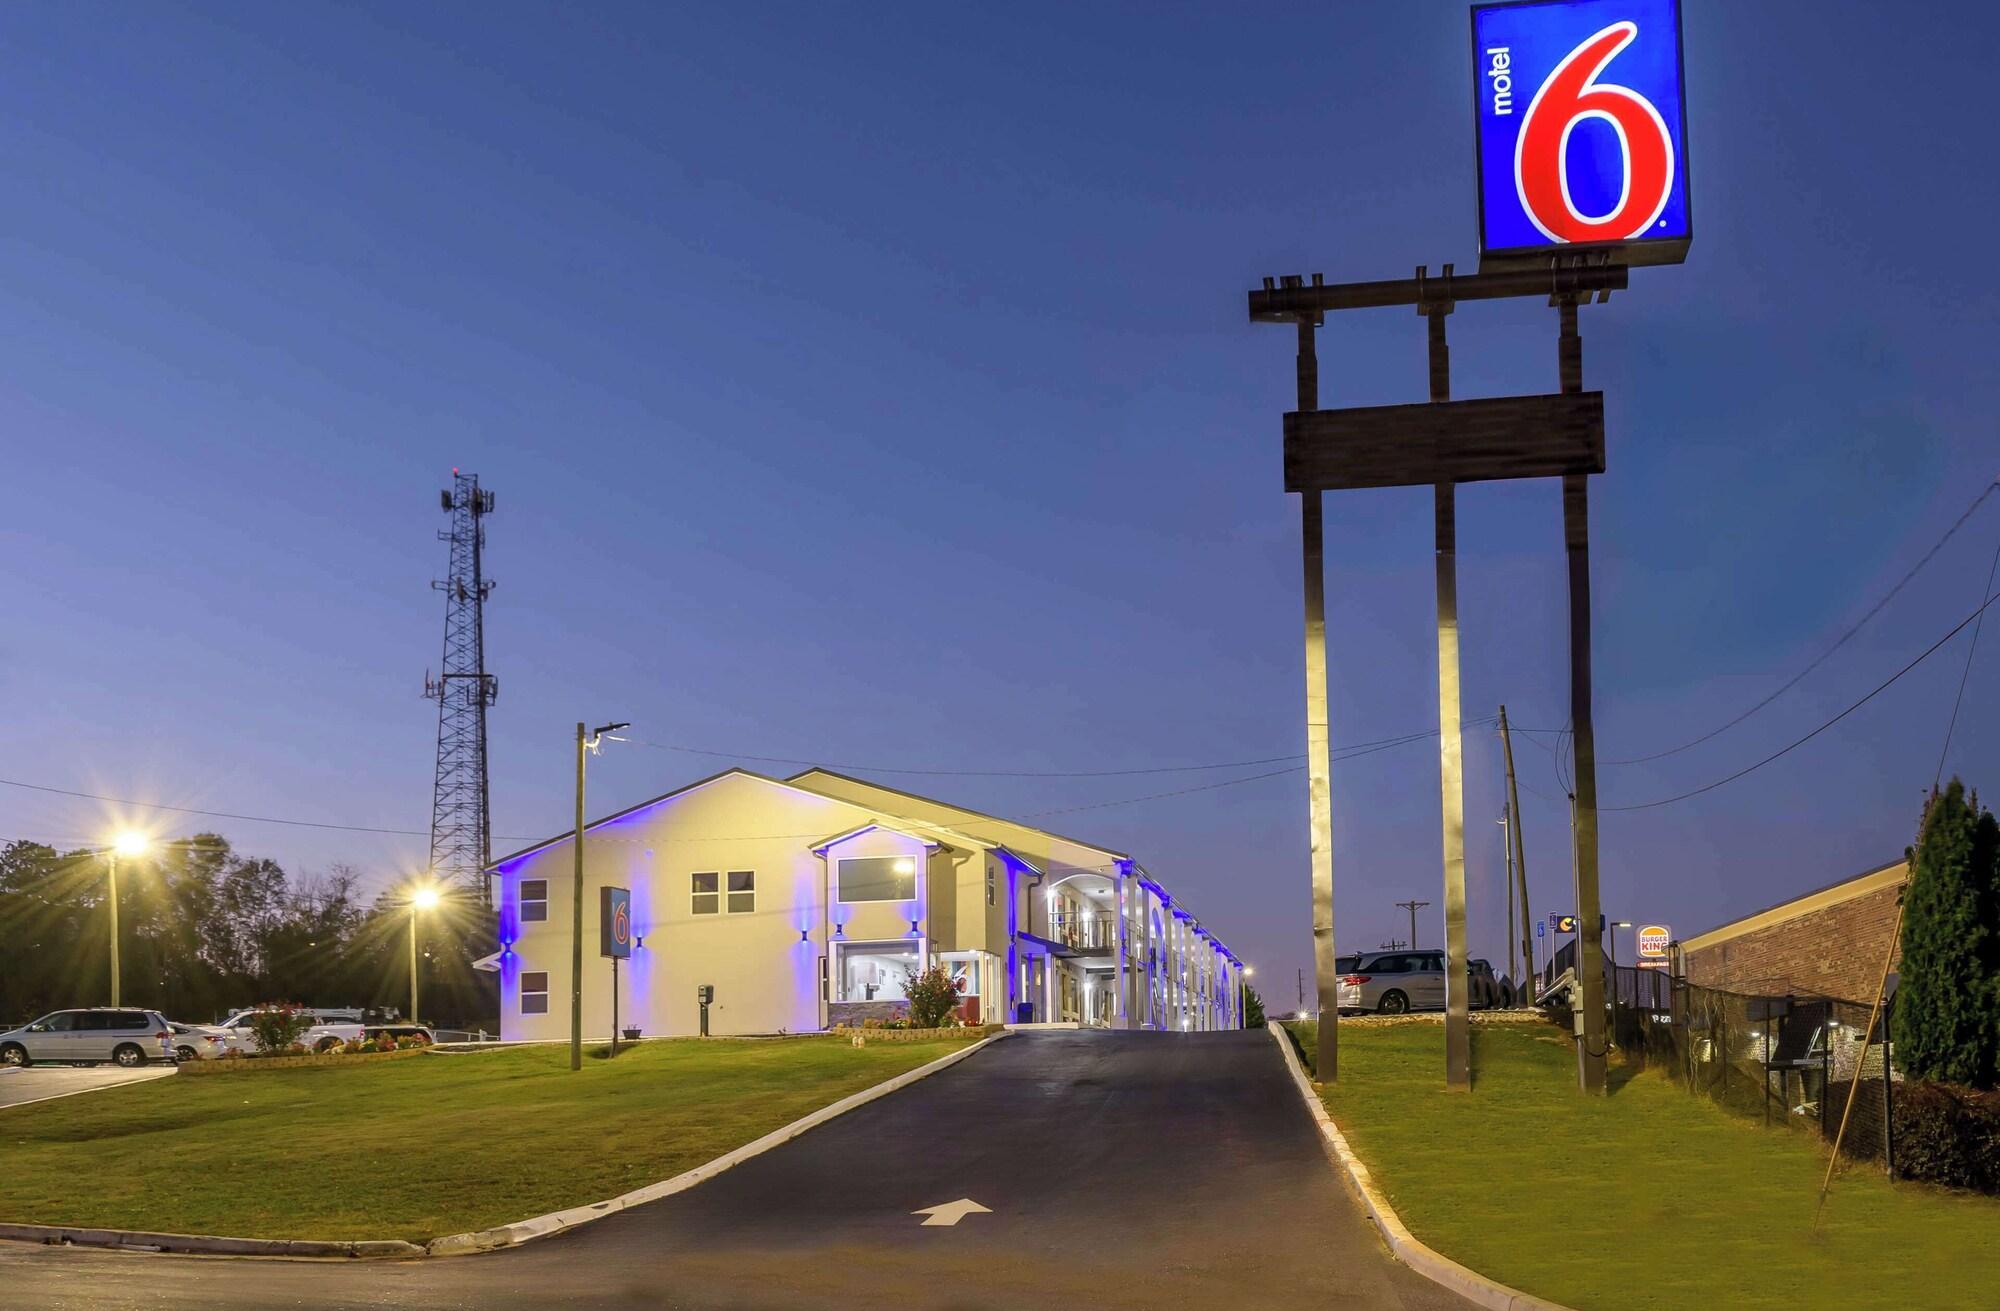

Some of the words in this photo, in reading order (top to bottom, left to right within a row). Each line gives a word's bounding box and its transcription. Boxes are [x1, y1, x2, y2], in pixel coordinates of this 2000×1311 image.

[1486, 47, 1512, 115] motel
[1514, 20, 1675, 243] 6
[614, 901, 629, 945] 6
